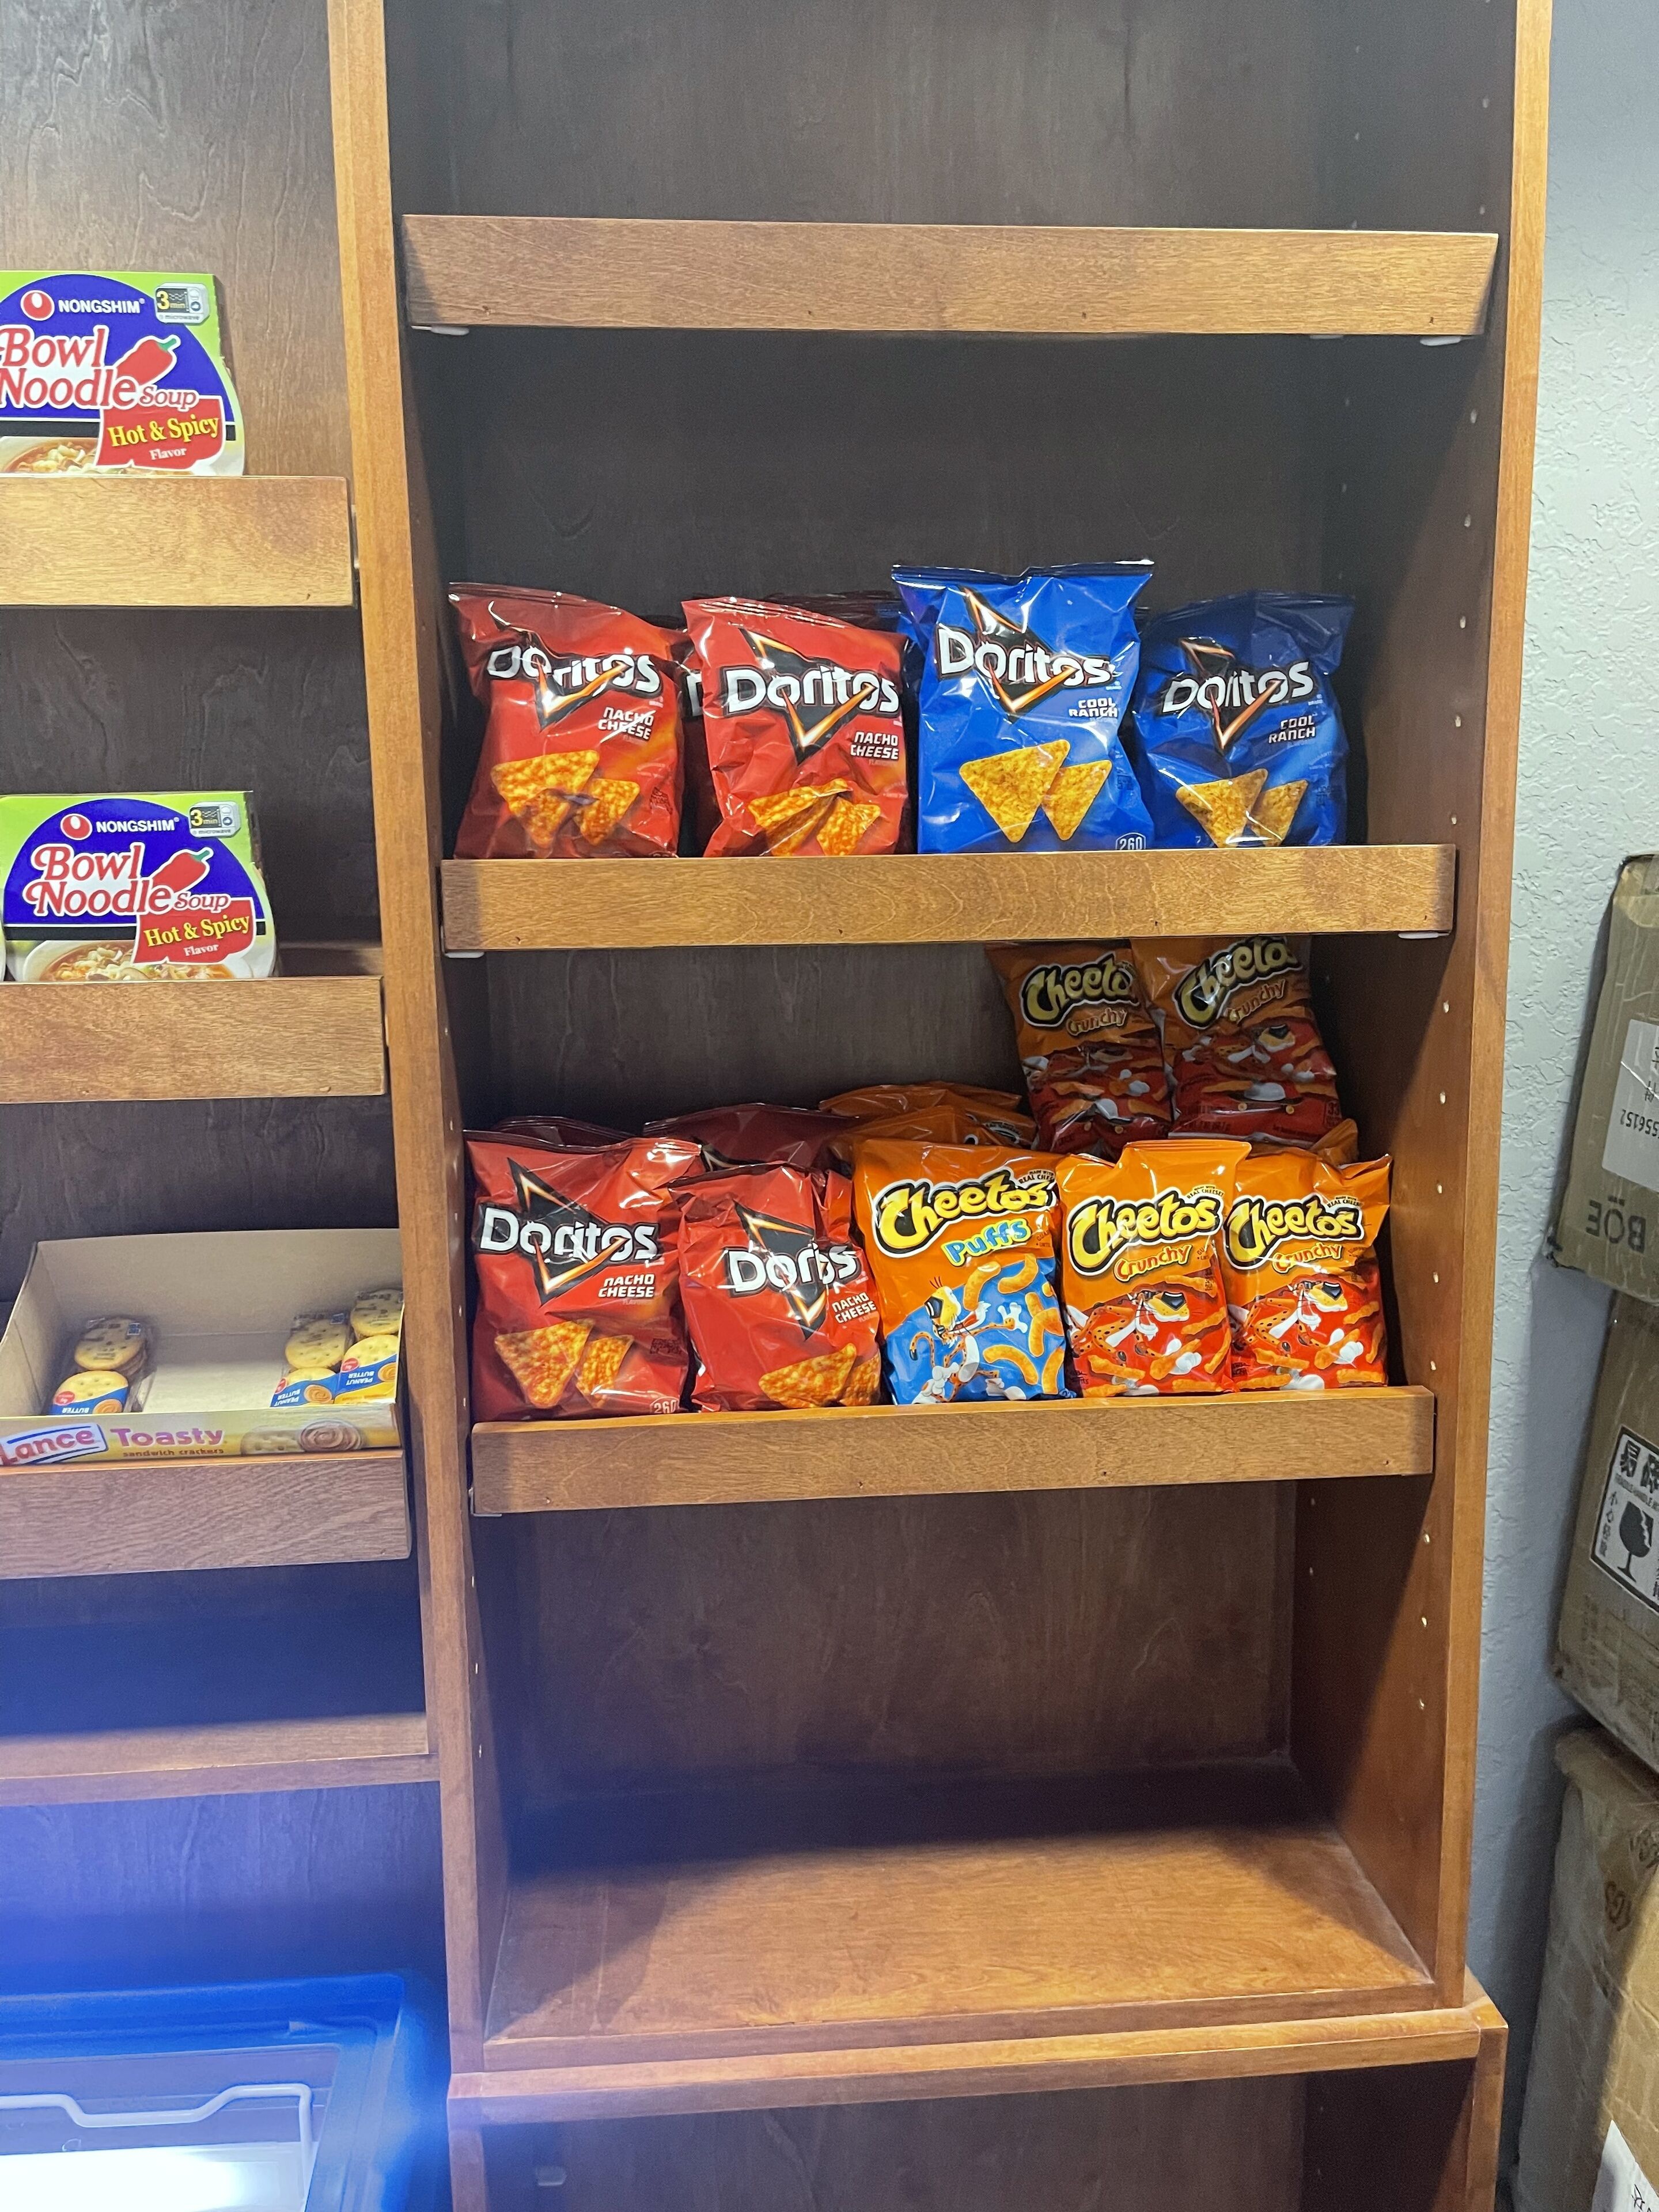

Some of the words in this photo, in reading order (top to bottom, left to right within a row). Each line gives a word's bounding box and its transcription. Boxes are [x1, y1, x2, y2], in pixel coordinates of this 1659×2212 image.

[59, 299, 140, 313] NONGSHIM
[156, 291, 170, 310] 3
[0, 328, 106, 367] Bowl
[0, 368, 136, 407] Noodle
[139, 385, 197, 409] Soup
[108, 425, 146, 447] Hot
[150, 422, 166, 441] &
[168, 414, 220, 444] Spicy
[149, 447, 187, 460] Flavor
[938, 627, 1113, 687] Doritos
[487, 645, 660, 694] Doritos
[726, 664, 900, 714] Doritos
[1162, 661, 1314, 713] Doritos
[1068, 707, 1118, 718] RANCH
[1078, 697, 1116, 709] COOL
[603, 706, 655, 726] NACHO
[1280, 715, 1315, 730] COOL
[597, 718, 653, 741] CHEESE
[854, 731, 899, 747] NACHO
[1268, 726, 1316, 744] RANCH
[850, 744, 899, 760] CHEESE
[96, 819, 175, 833] NONGSHIM
[190, 809, 203, 827] 3
[1119, 836, 1143, 850] 260
[33, 845, 142, 881] Bowl
[25, 880, 172, 915] Noodle
[174, 892, 230, 913] Soup
[143, 927, 182, 948] Hot
[184, 922, 199, 940] &
[202, 914, 250, 938] Spicy
[183, 943, 219, 957] Flavor
[1023, 955, 1131, 1021] Cheeto
[1180, 937, 1298, 1024] Cheeto
[1066, 1007, 1127, 1036] Crunchy
[1620, 1108, 1659, 1139] 556152
[1018, 1175, 1035, 1184] REAL
[1186, 1190, 1200, 1199] REAL
[878, 1173, 1051, 1249] Cheetos
[479, 1207, 658, 1262] Doritos
[1071, 1194, 1220, 1270] Cheetos
[1226, 1198, 1359, 1263] Cheetos
[941, 1218, 1031, 1266] Puffs
[1114, 1244, 1192, 1281] Crunchy
[1272, 1243, 1342, 1272] Crunchy
[603, 1274, 655, 1287] NACHO
[598, 1286, 655, 1298] CHEESE
[831, 1291, 869, 1313] NACHO
[835, 1301, 877, 1324] CHEESE
[346, 1377, 374, 1386] PEANUT
[348, 1370, 375, 1379] BUTTER
[277, 1388, 301, 1400] BUTTER
[653, 1400, 677, 1414] 260
[0, 1429, 95, 1467] Lance
[109, 1427, 224, 1447] Toasty
[123, 1449, 175, 1457] sandwich
